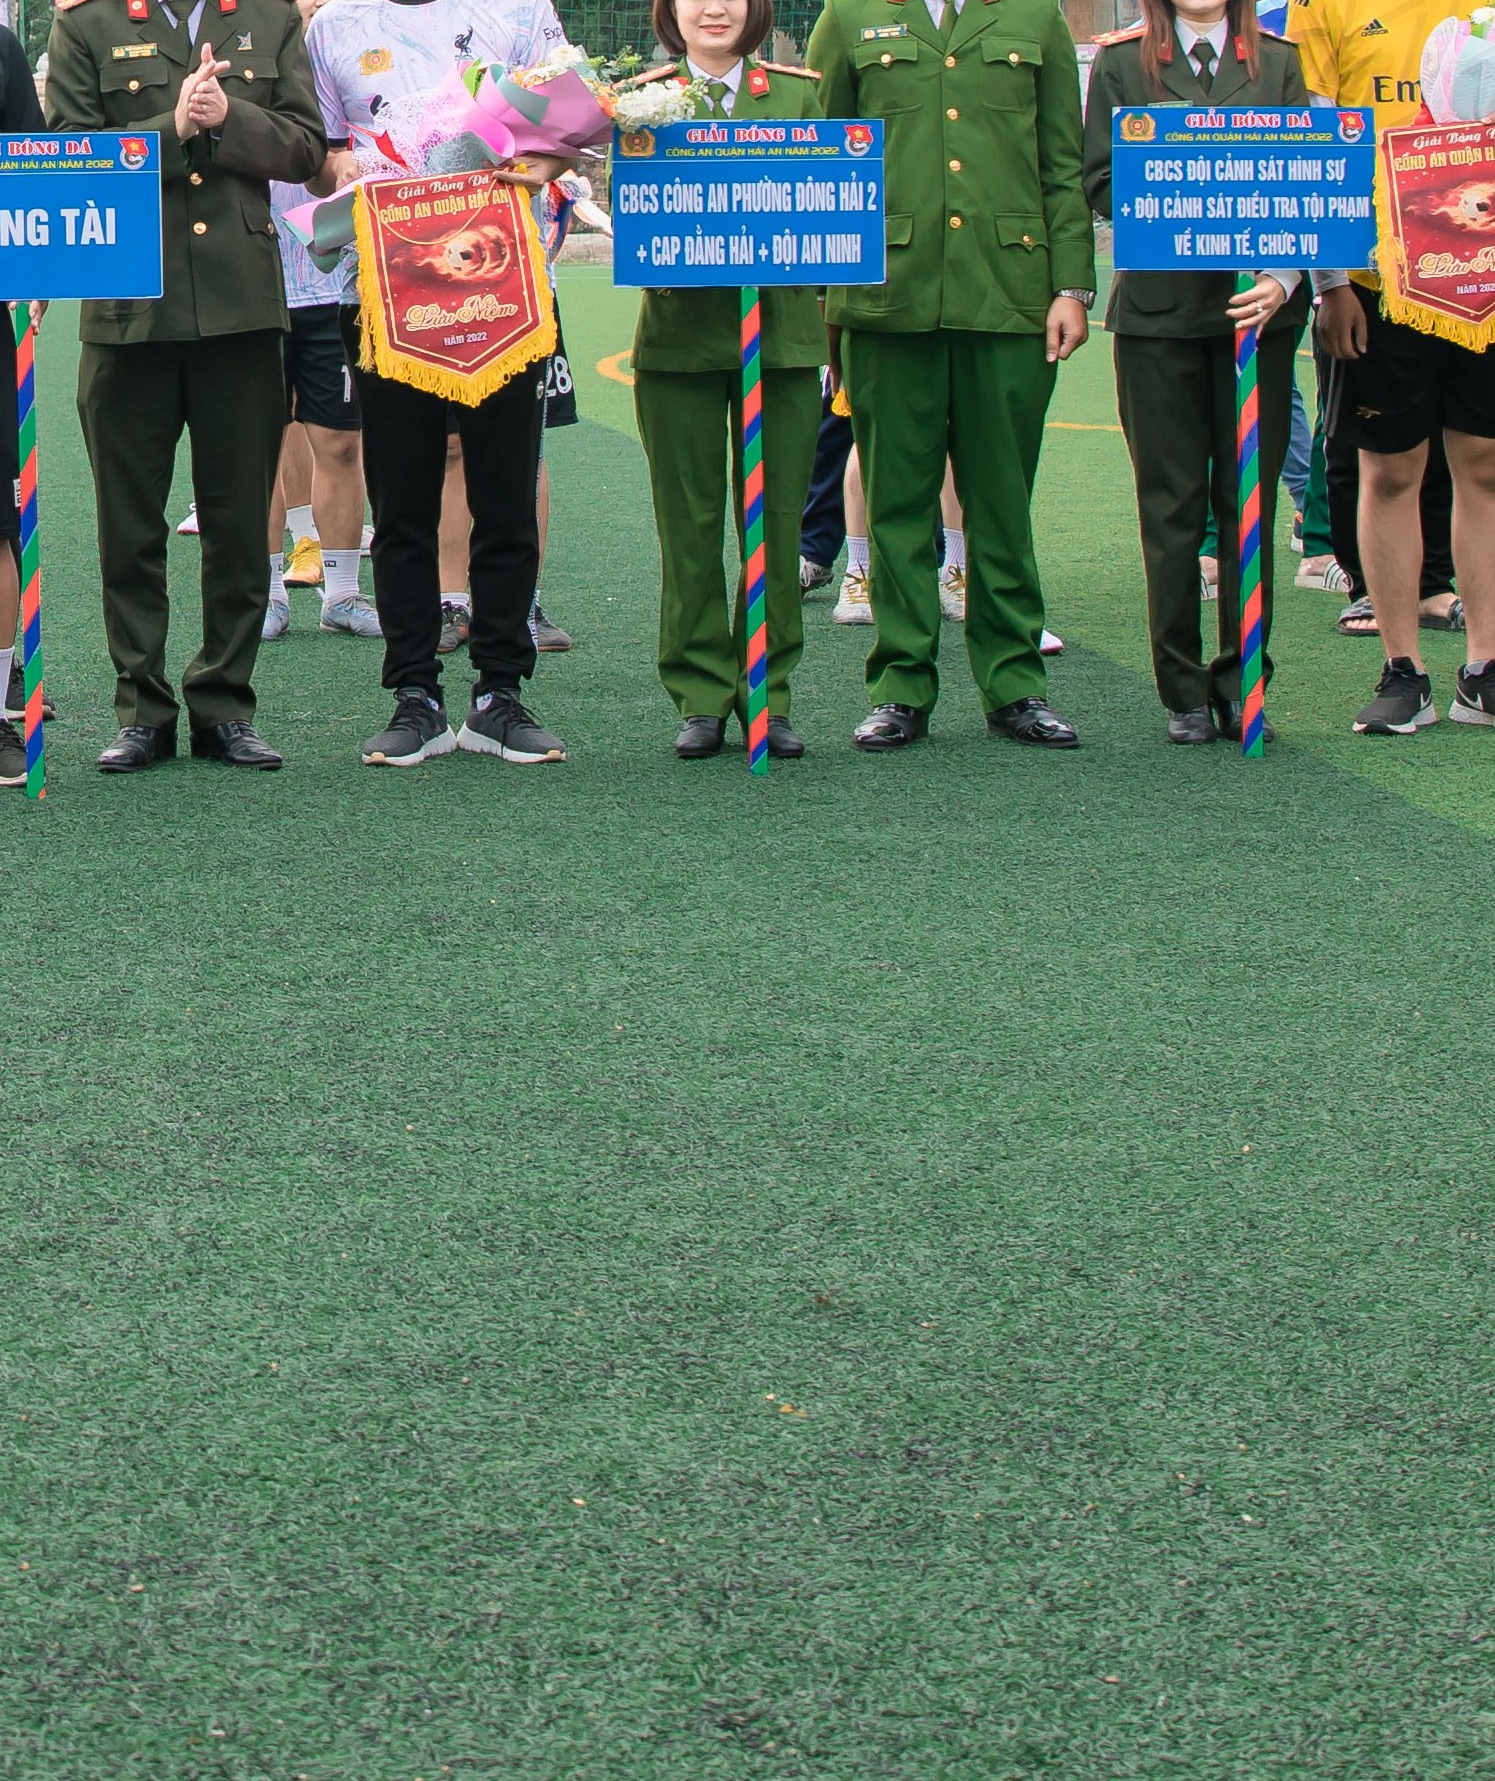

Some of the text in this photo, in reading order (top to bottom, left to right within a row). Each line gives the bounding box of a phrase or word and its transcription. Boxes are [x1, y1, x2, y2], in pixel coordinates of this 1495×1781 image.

[8, 138, 59, 156] BÓNG
[66, 137, 92, 155] ĐÁ
[686, 123, 818, 143] GIẢI BÓNG ĐÁ
[86, 160, 113, 168] 2022
[1146, 153, 1346, 185] CBCS ĐỘI CẢNH SÁT HÌNH SỰ
[620, 172, 876, 213] CBCS CÔNG AN PHƯỜNG ĐÔNG HẢI 2
[1135, 190, 1369, 223] ĐỘI CẢNH SÁT ĐIỀU TRA TỘI PHẠM
[61, 200, 115, 245] TÀI
[652, 225, 861, 270] CAP ĐẰNG HẢI ĐỘI AN NINH
[1197, 235, 1230, 255] KINH
[1234, 228, 1254, 257] TẾ,
[1259, 230, 1296, 255] CHỨC
[1300, 234, 1318, 259] VỤ
[545, 356, 573, 397] 28
